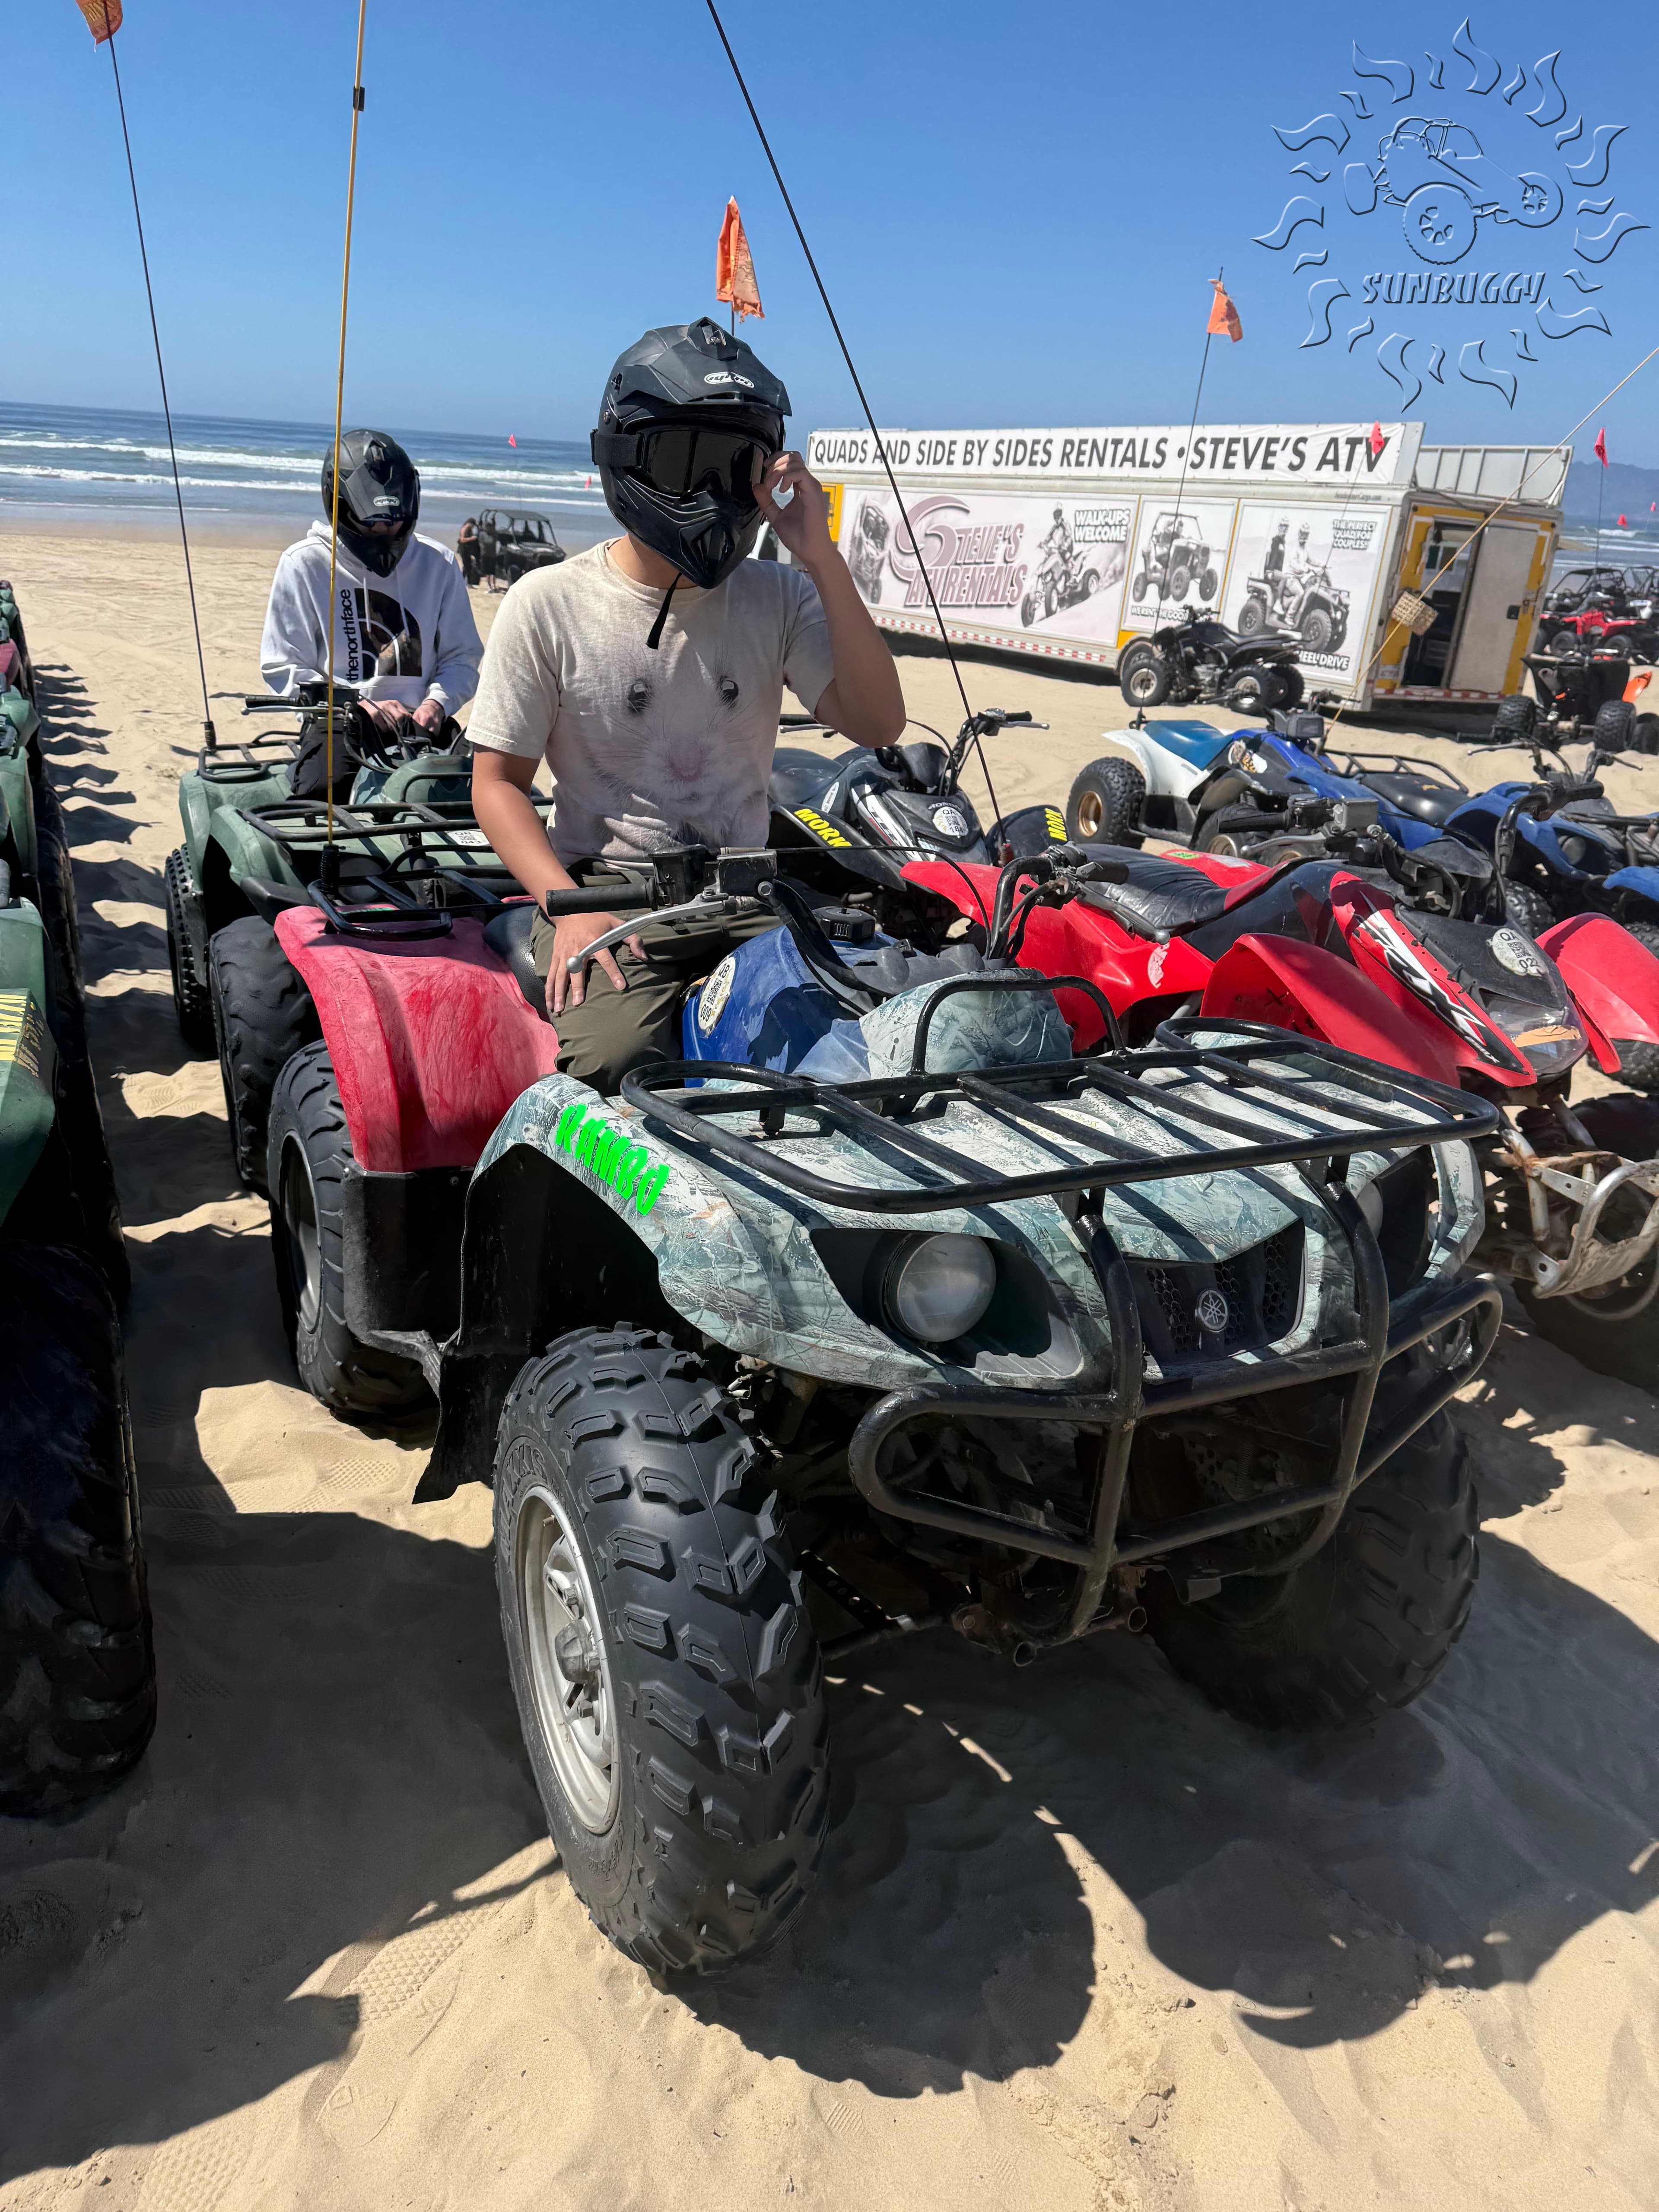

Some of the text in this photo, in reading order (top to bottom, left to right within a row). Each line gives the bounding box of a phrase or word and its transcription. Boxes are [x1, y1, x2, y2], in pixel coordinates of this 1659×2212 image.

[815, 436, 1391, 473] QUADS AND SIDE BY SIDES RENTALS STEVE'S ATV
[1075, 509, 1131, 526] WALK-UPS
[1074, 525, 1128, 543] WELCOME
[940, 564, 1028, 606] RENTALS
[1318, 652, 1350, 671] DRIVE
[700, 1004, 712, 1022] 009
[555, 1103, 671, 1216] RAMBO
